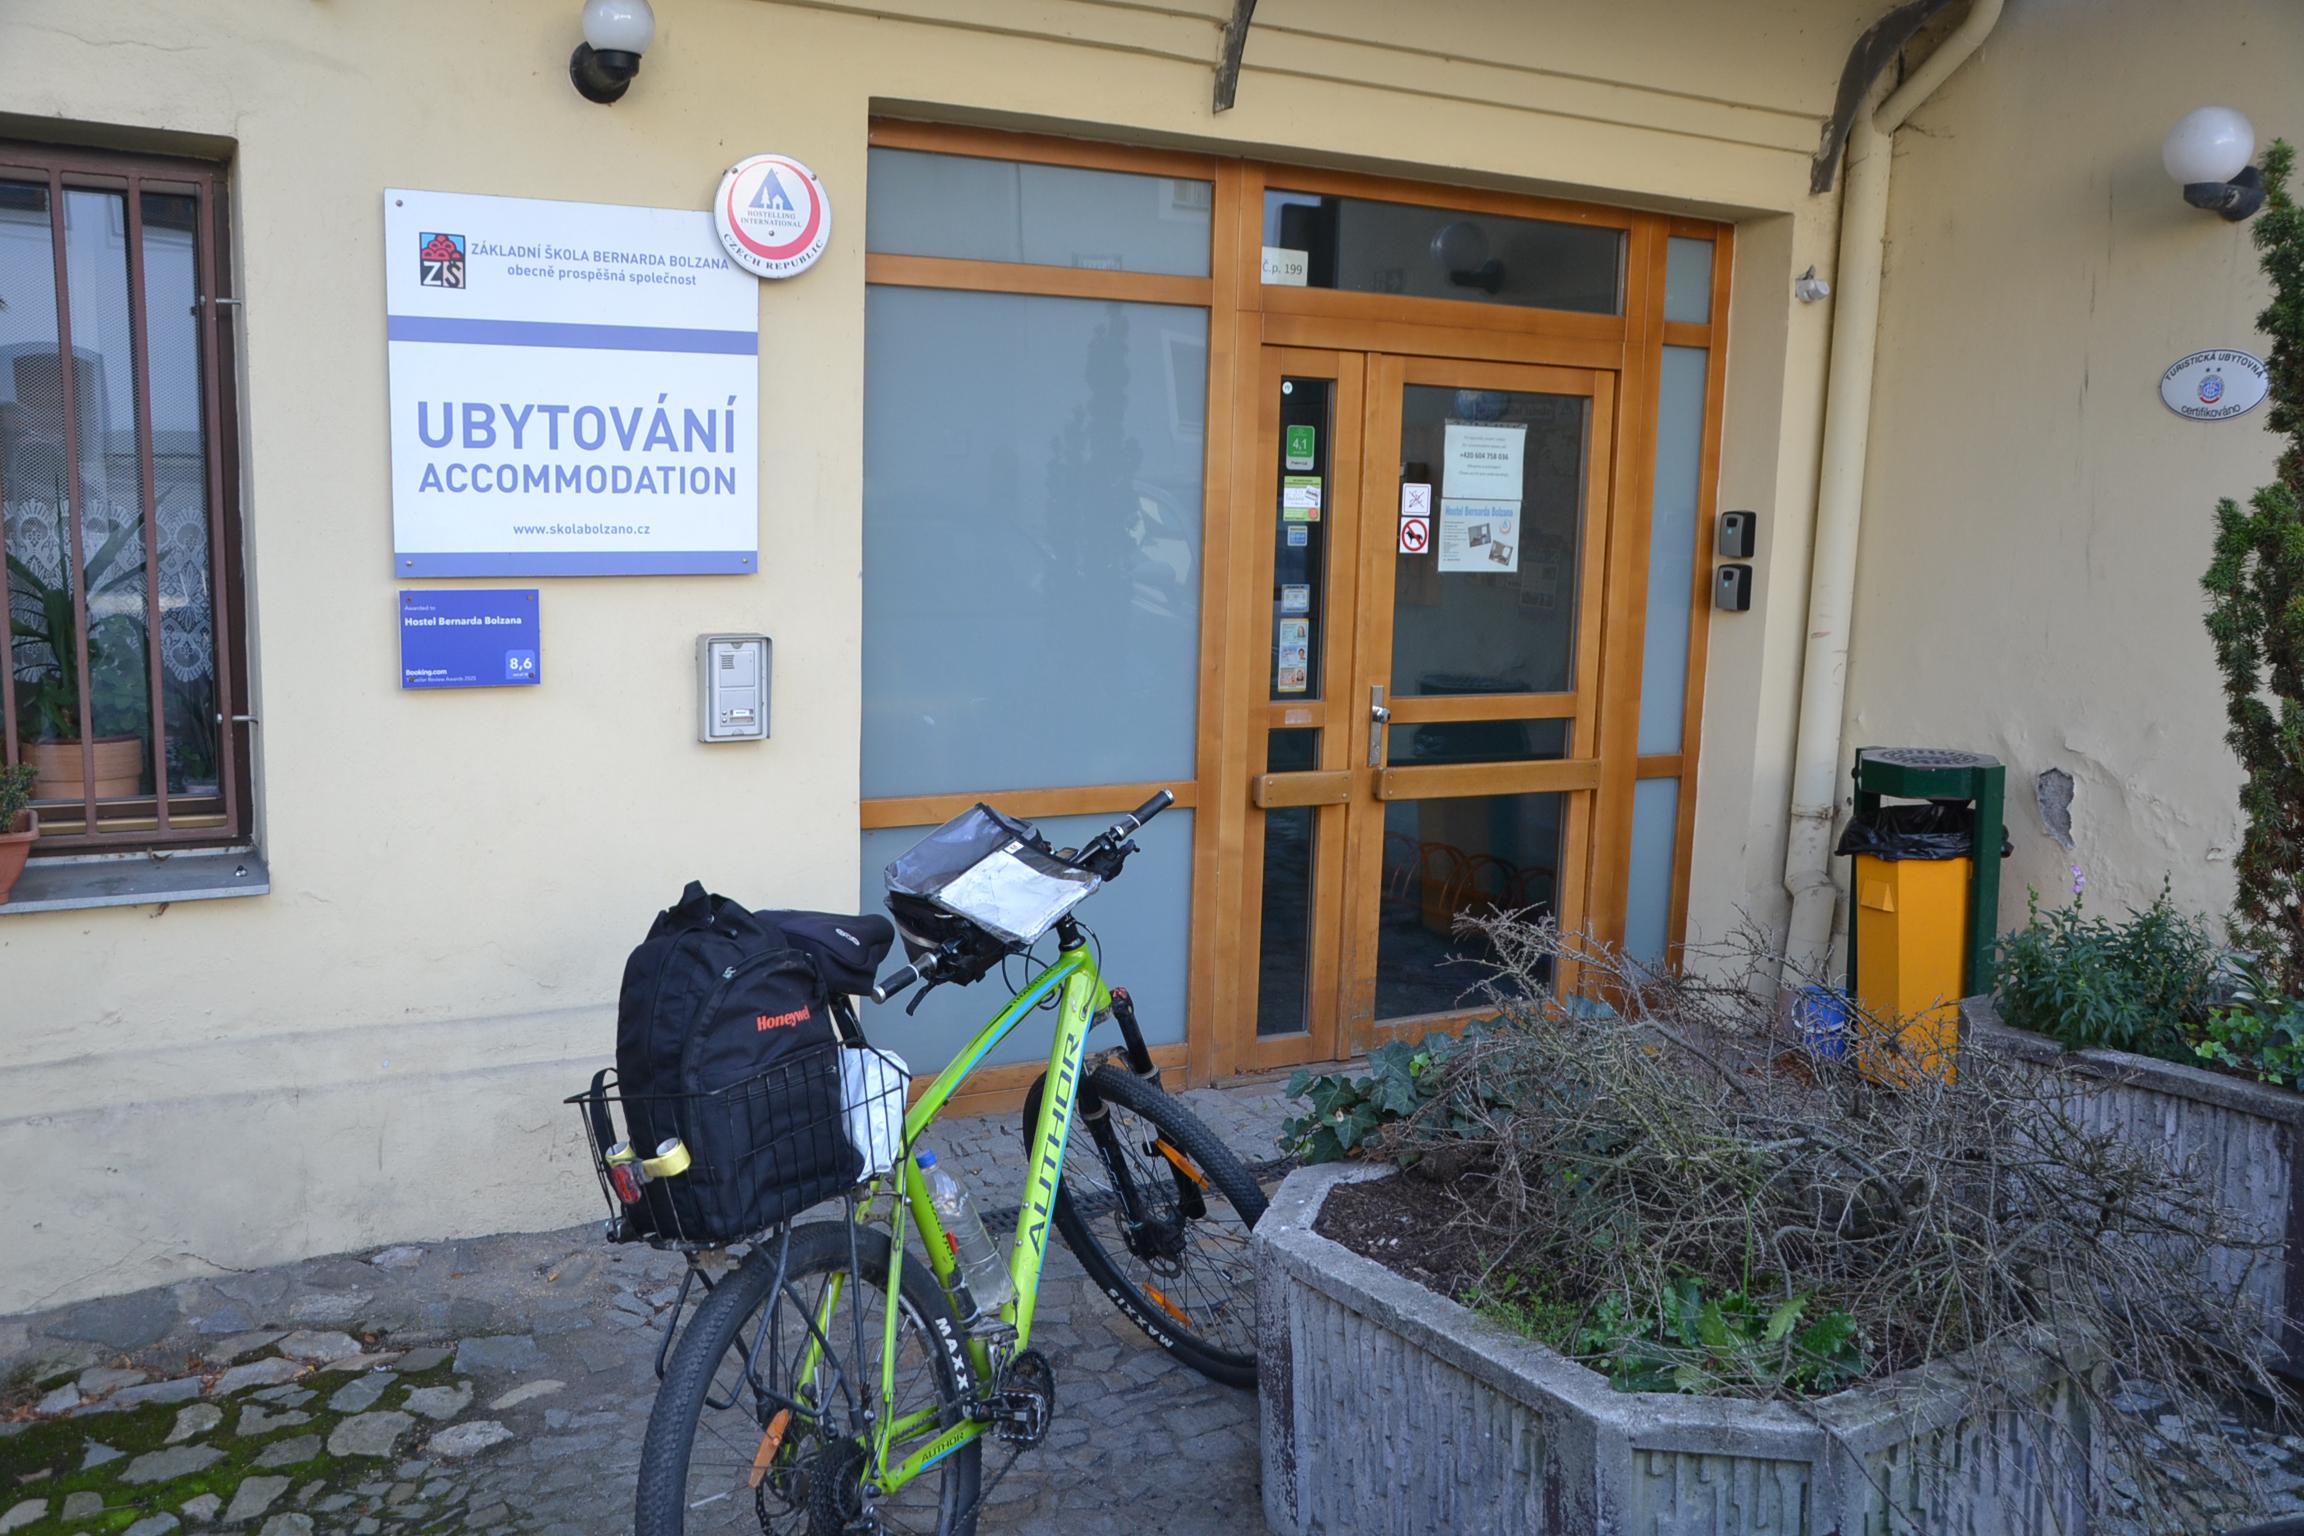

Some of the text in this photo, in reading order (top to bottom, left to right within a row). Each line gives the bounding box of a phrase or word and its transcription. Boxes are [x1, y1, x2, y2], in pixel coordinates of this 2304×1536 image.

[740, 217, 802, 228] INTERNATIONAL
[747, 209, 796, 219] HOSTELLING
[471, 240, 730, 270] ZÁKLADNÍ ŠKOLA BERNARDA BOLZANA
[723, 233, 824, 270] CZECH REPUBLIC
[507, 264, 697, 286] obecně prospěšná společnost
[1285, 263, 1303, 276] 199
[2165, 351, 2264, 381] TURISTICKÁ UBYTOVNA
[417, 393, 738, 454] UBYTOVÁNÍ
[2181, 403, 2241, 418] certifikováno
[418, 463, 737, 496] ACCOMMODATION
[513, 522, 651, 536] www.skolabolzano.cz
[404, 616, 522, 626] Hostel Bernarda Bolzana
[405, 669, 448, 677] Booking.com
[509, 657, 533, 671] 8,6
[1028, 1033, 1080, 1257] AUTHOR
[1107, 1287, 1174, 1349] MAXXIS
[935, 1317, 973, 1418] MAXXS
[920, 1431, 966, 1463] AUTHOR
